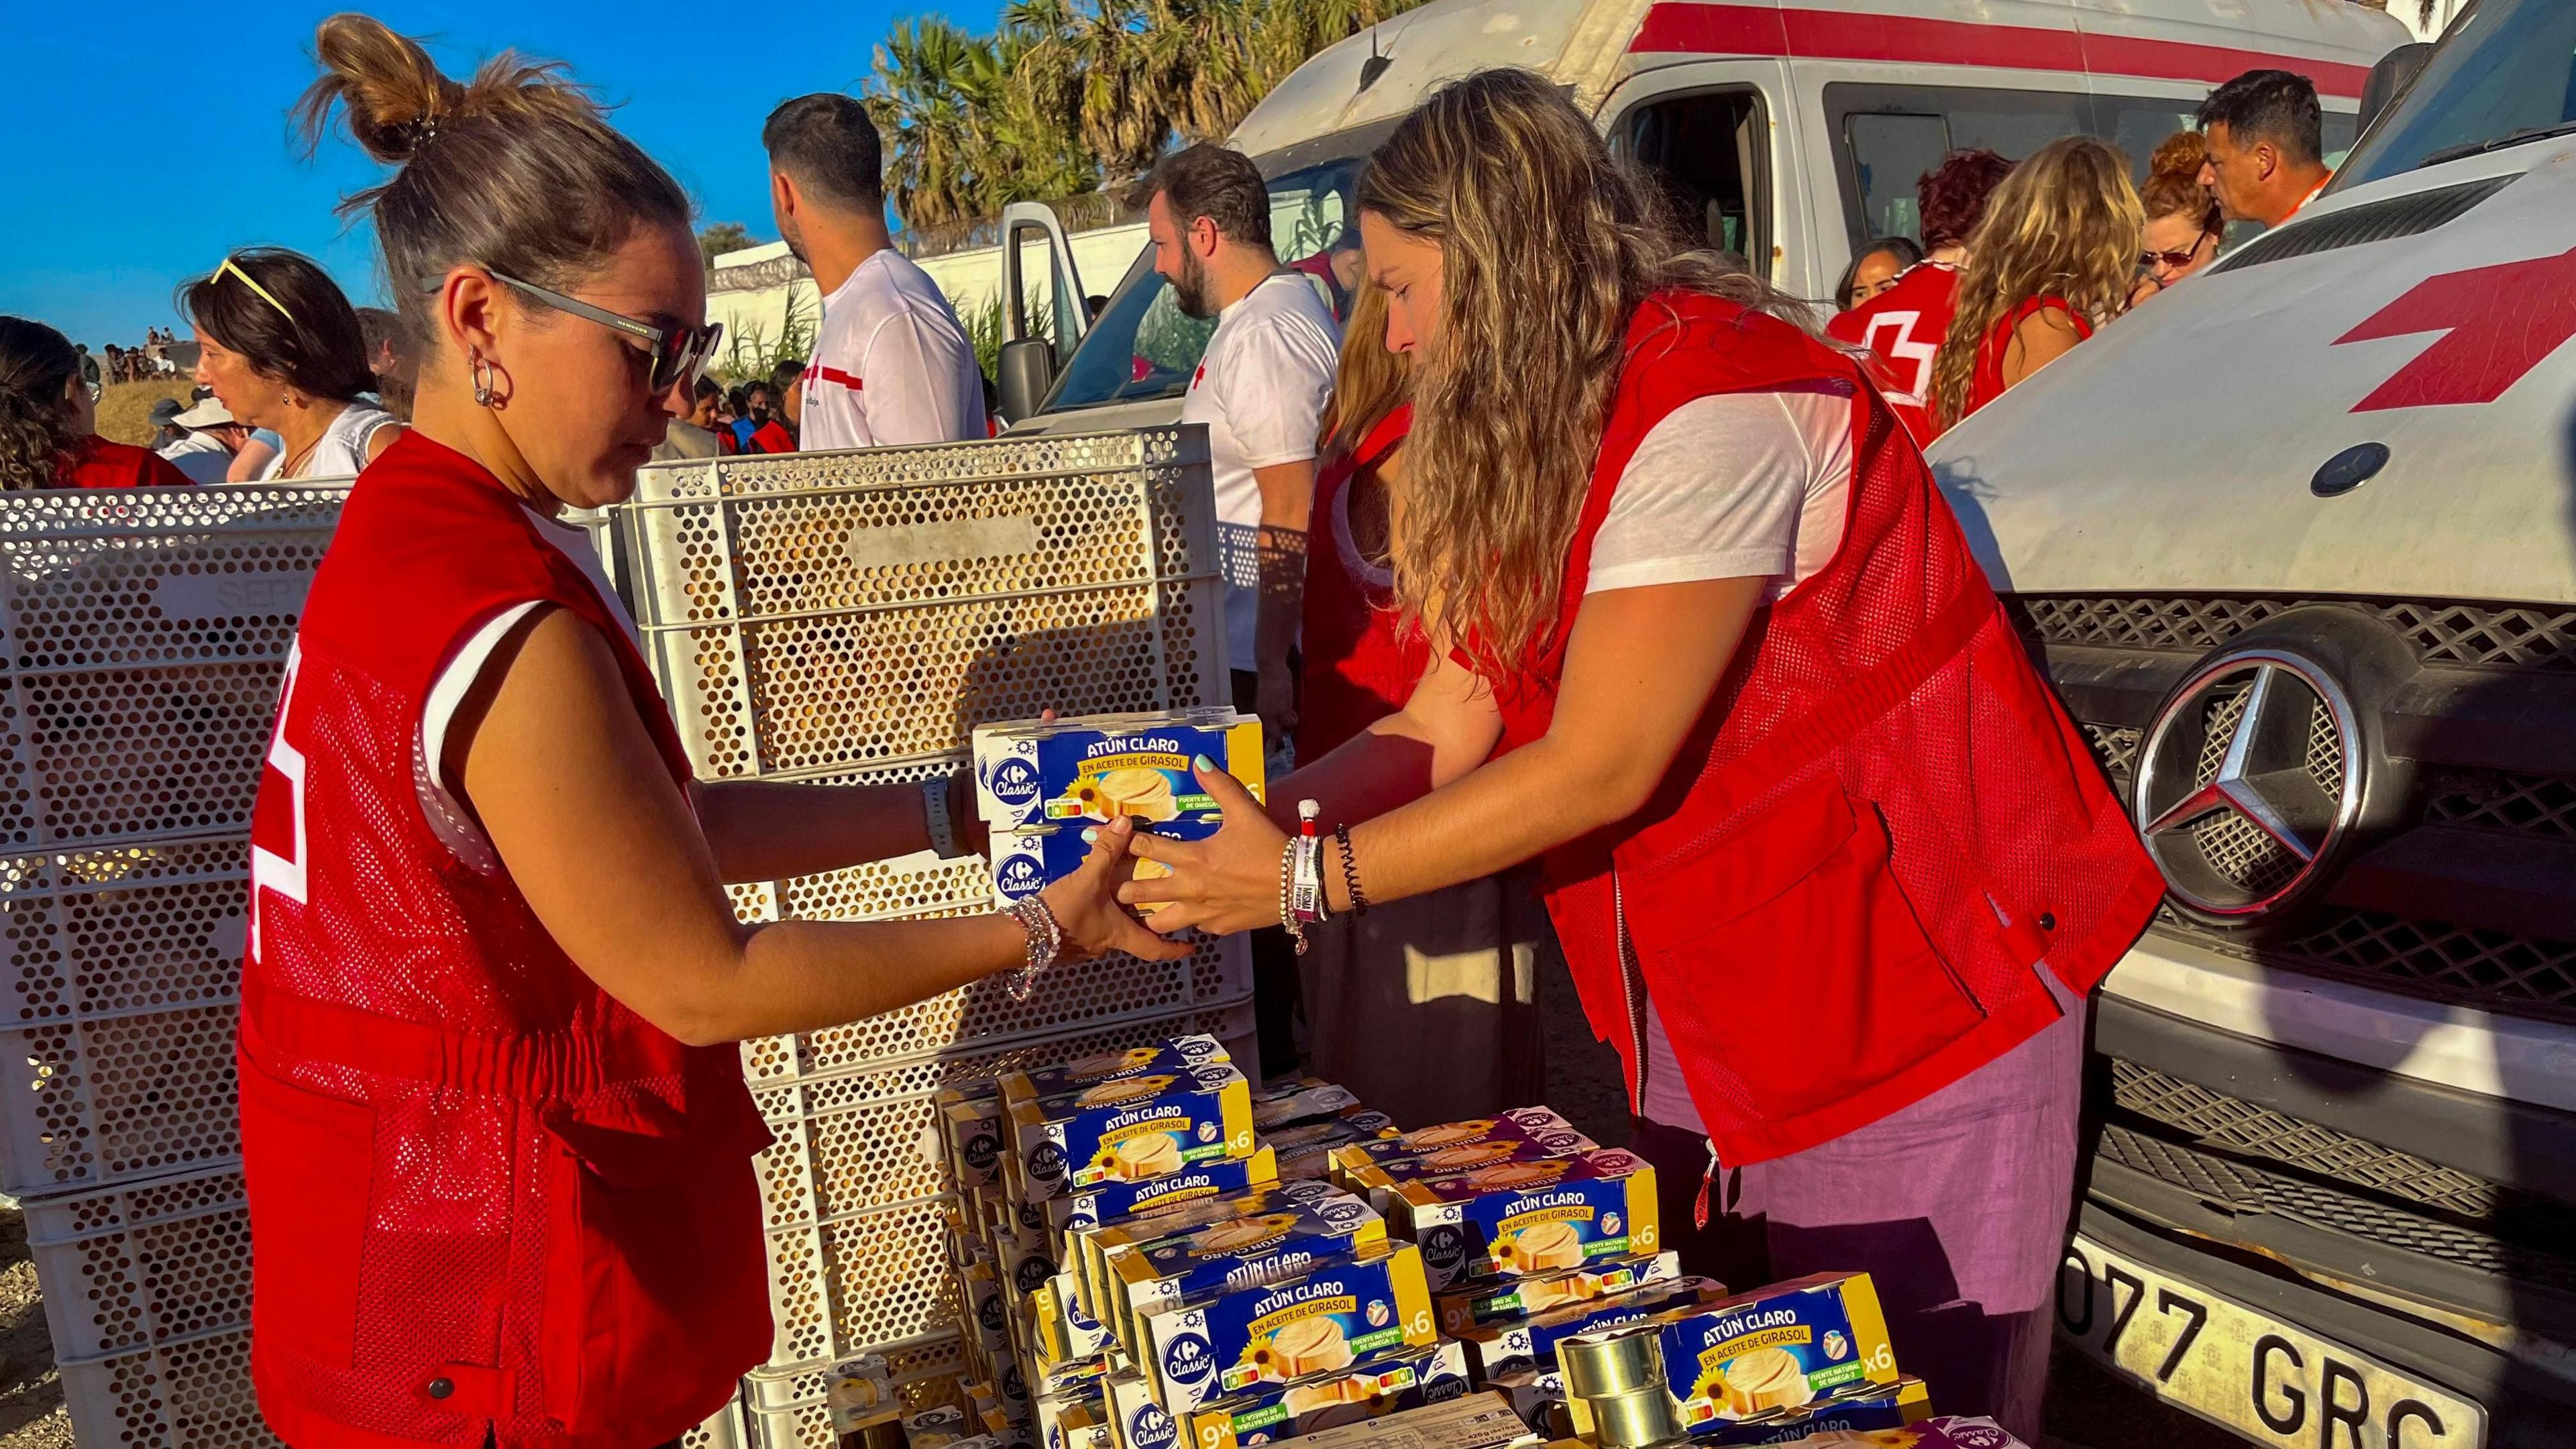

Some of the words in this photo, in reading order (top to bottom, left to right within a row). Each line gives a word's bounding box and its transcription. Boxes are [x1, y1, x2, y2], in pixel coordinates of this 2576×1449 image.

[1087, 737, 1128, 758] ATÚN
[1129, 737, 1179, 753] CLARO
[1082, 763, 1095, 773] EN
[1095, 759, 1126, 771] ACEITE
[1127, 757, 1138, 767] DE
[1139, 755, 1184, 768] GIRASOL
[995, 781, 1037, 797] Classic
[1001, 877, 1042, 894] Classic
[1301, 887, 1313, 910] MISMA
[1075, 1074, 1114, 1084] CLARO
[1085, 1099, 1127, 1110] CLARO
[1106, 1108, 1139, 1132] ATÚN
[1140, 1106, 1181, 1121] CLARO
[1102, 1136, 1112, 1145] EN
[1113, 1128, 1138, 1142] ACEITE
[1140, 1125, 1149, 1134] DE
[1150, 1120, 1187, 1132] GIRASOL
[1227, 1130, 1250, 1152] x6
[1413, 1141, 1456, 1154] CLARO
[1030, 1159, 1067, 1175] Classic
[1434, 1161, 1477, 1174] CLARO
[1135, 1181, 1169, 1202] ATÚN
[1170, 1175, 1210, 1190] CLARO
[1481, 1181, 1523, 1193] CLARO
[1505, 1195, 1541, 1217] ATÚN
[1542, 1193, 1585, 1206] CLARO
[1501, 1223, 1512, 1231] EN
[1513, 1216, 1540, 1228] ACEITE
[1540, 1213, 1550, 1221] DE
[1551, 1208, 1590, 1220] GIRASOL
[1250, 1234, 1287, 1251] ATÚN
[1631, 1225, 1655, 1247] x6
[1201, 1247, 1249, 1260] CLARO
[1226, 1260, 1265, 1283] ATÚN
[1266, 1252, 1311, 1271] CLARO
[1254, 1290, 1294, 1317] ATÚN
[1295, 1281, 1344, 1301] CLARO
[1253, 1324, 1265, 1334] EN
[1266, 1313, 1295, 1331] ACEITE
[1296, 1308, 1307, 1317] DE
[1308, 1299, 1352, 1314] GIRASOL
[1403, 1310, 1431, 1338] x6
[1446, 1306, 1471, 1331] 9x
[1352, 1336, 1374, 1346] FUENTE
[1374, 1330, 1401, 1341] NATURAL
[1703, 1319, 1744, 1347] ATÚN
[1746, 1309, 1796, 1330] CLARO
[1703, 1355, 1717, 1366] EN
[1717, 1343, 1746, 1362] ACEITE
[1747, 1337, 1760, 1349] DE
[1761, 1329, 1808, 1345] GIRASOL
[1169, 1356, 1210, 1377] Classic
[1864, 1343, 1892, 1374] x6
[1810, 1371, 1833, 1383] FUENTE
[1833, 1362, 1861, 1376] NATURAL
[1818, 1379, 1827, 1387] DE
[1264, 1412, 1286, 1424] FUENTE
[1269, 1407, 1277, 1415] DE
[1203, 1421, 1232, 1449] 9x
[1235, 1417, 1263, 1432] NATURAL
[1952, 1426, 1998, 1442] Classic
[1136, 1427, 1176, 1446] Classic
